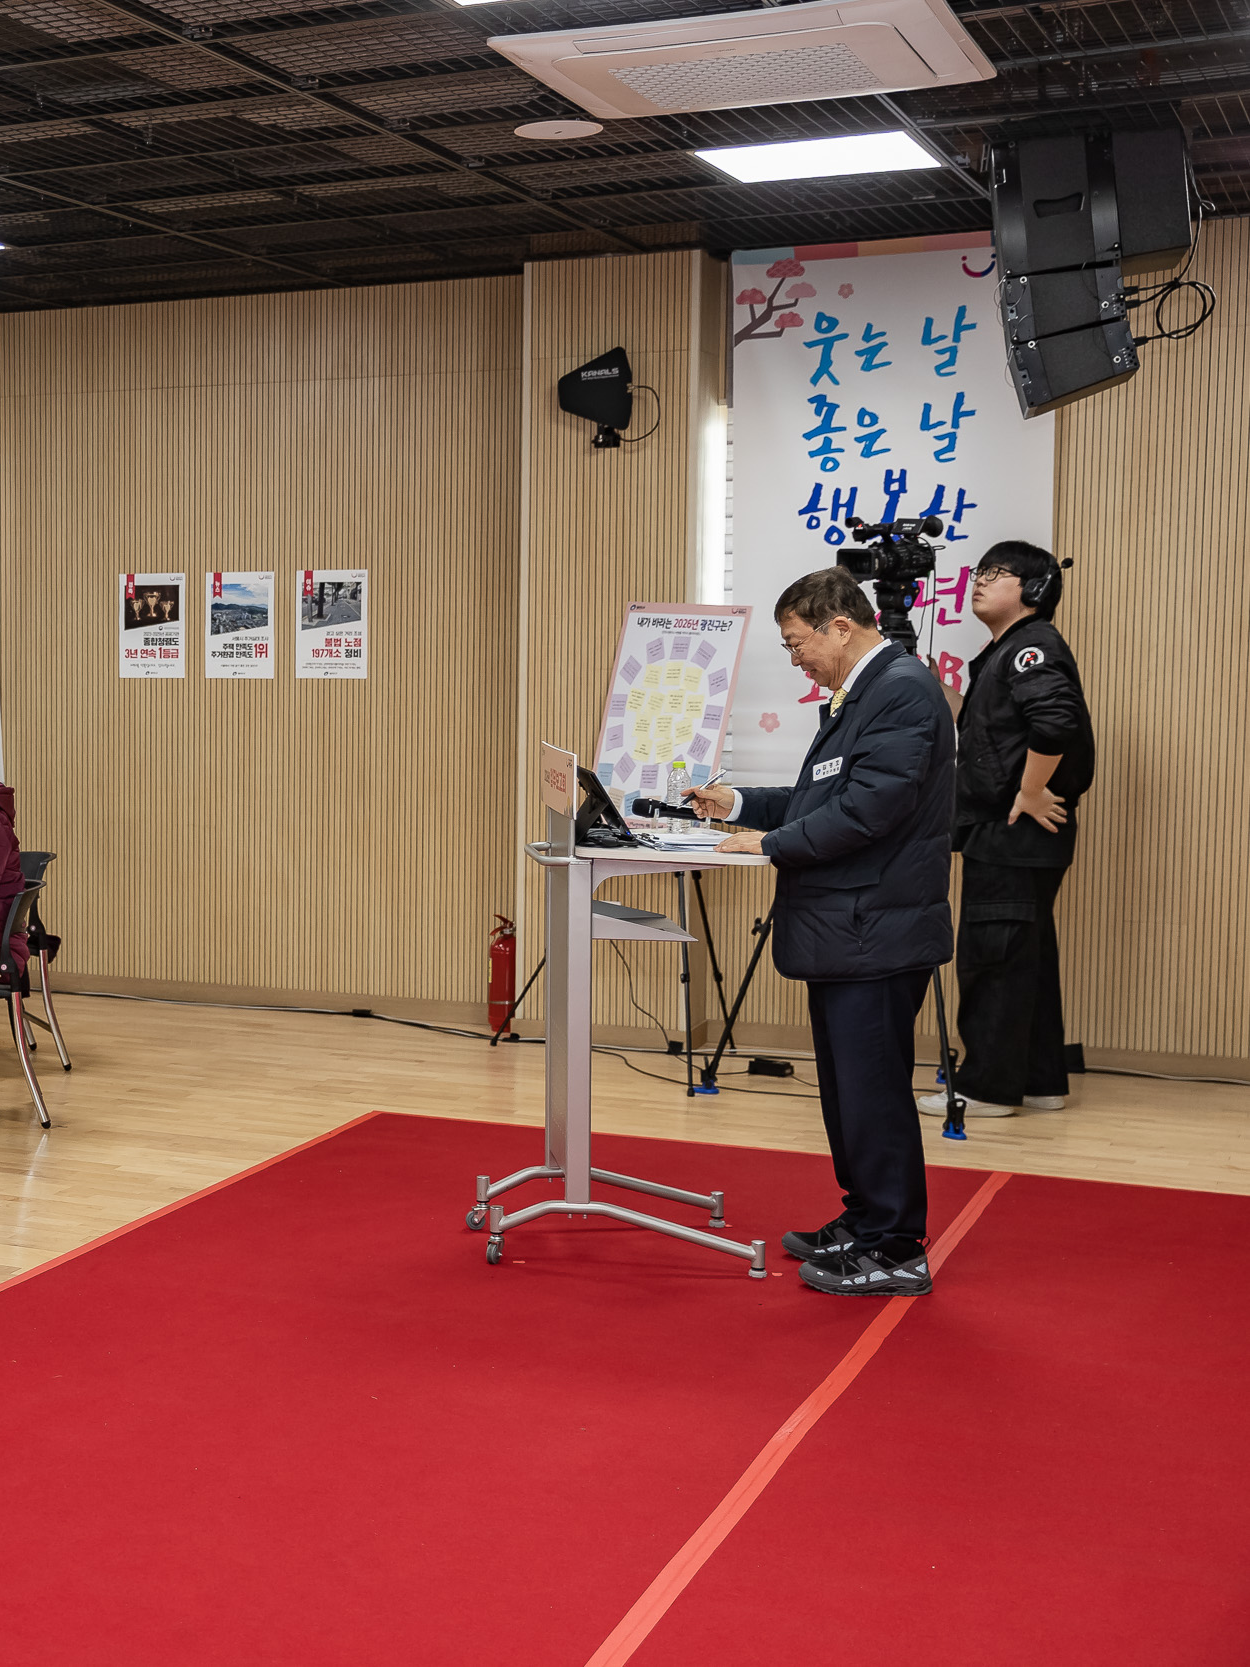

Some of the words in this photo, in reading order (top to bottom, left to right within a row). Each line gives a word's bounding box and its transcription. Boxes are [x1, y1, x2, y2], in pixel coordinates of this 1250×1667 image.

[803, 311, 892, 387] 웃는
[920, 305, 977, 377] 날
[581, 367, 619, 378] KANALS
[802, 394, 891, 472] 좋은
[919, 391, 977, 463] 날
[637, 617, 651, 628] 내가
[652, 618, 672, 630] 바라는
[673, 618, 699, 630] 2026년
[700, 619, 733, 632] 광진구는?
[235, 643, 253, 651] 만족도
[325, 637, 341, 648] 불법
[344, 637, 362, 648] 노점
[124, 648, 138, 659] 3년
[140, 648, 157, 659] 연속
[158, 646, 179, 659] 1등급
[254, 643, 269, 658] 1위
[311, 648, 342, 658] 197개소
[344, 648, 362, 658] 정비
